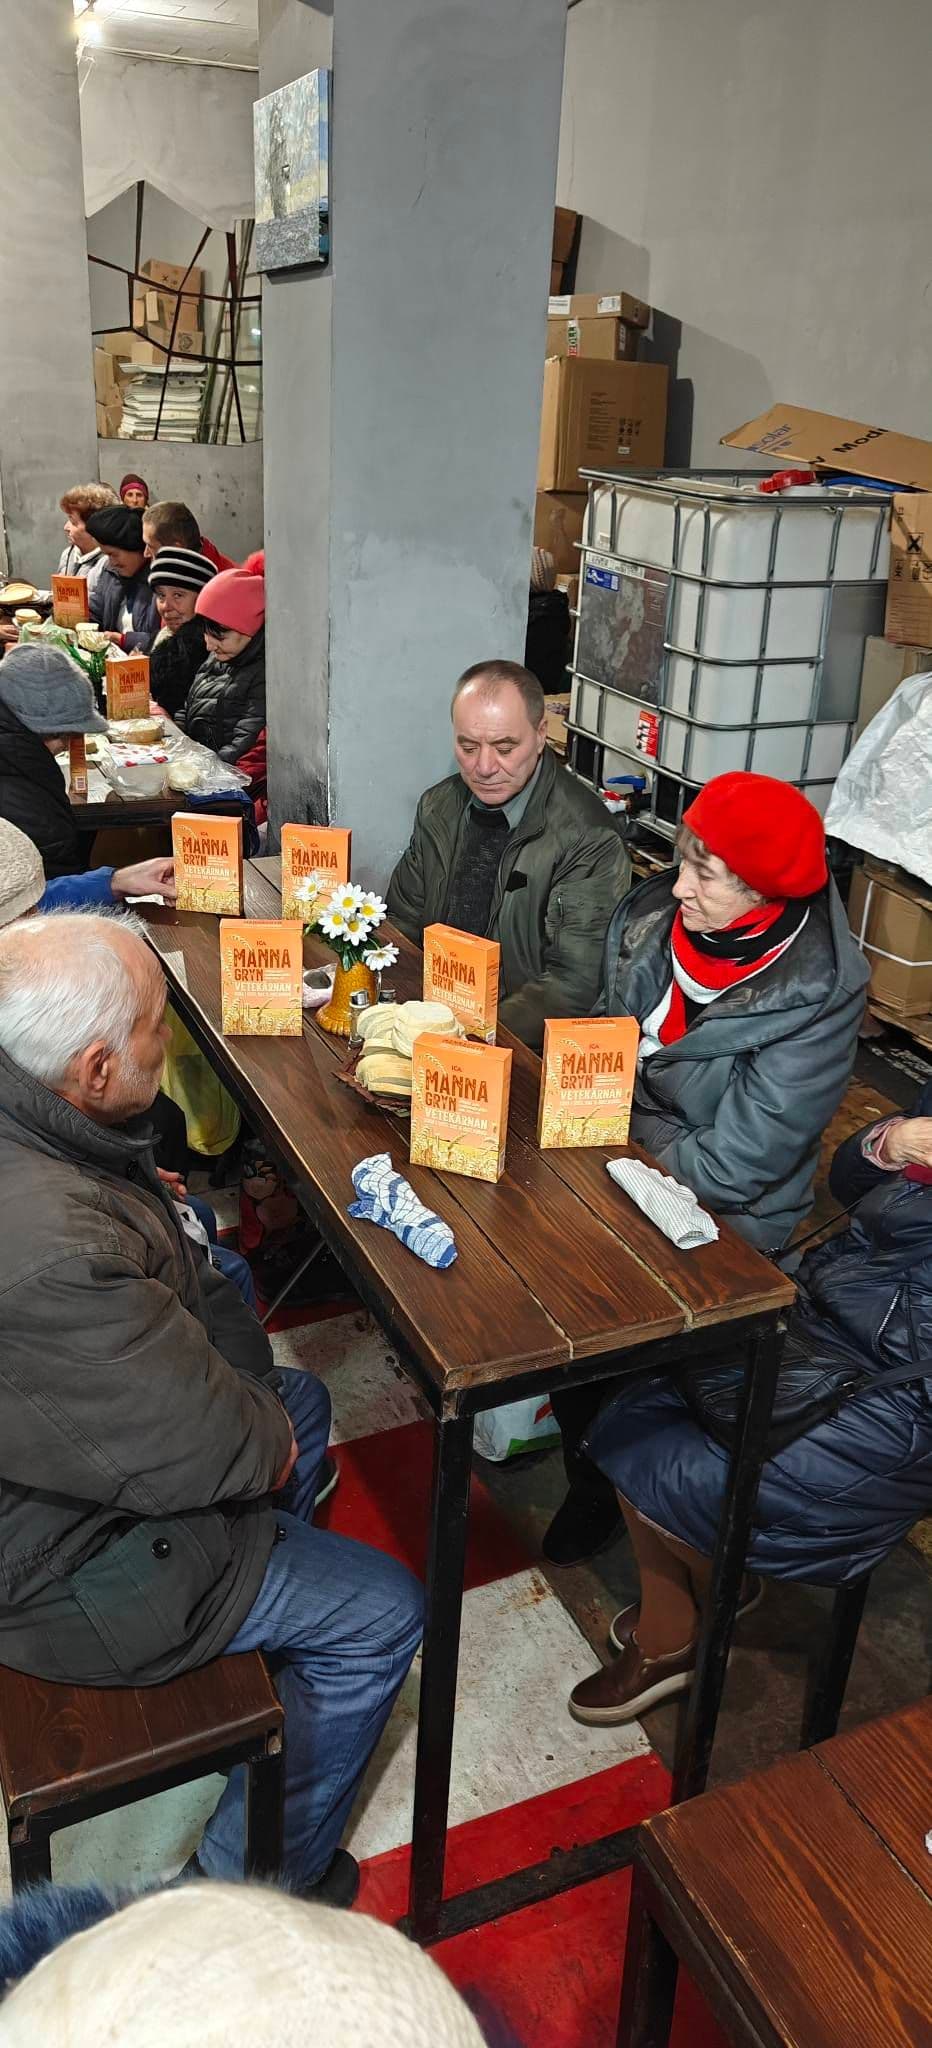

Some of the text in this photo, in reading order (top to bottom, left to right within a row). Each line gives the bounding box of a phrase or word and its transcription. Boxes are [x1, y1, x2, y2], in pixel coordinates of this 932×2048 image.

[119, 671, 145, 685] MANNA
[182, 836, 229, 857] MANNA
[183, 853, 207, 866] GRYN
[291, 847, 338, 868] MANNA
[233, 948, 291, 969] MANNA
[234, 968, 264, 982] GRYN
[432, 953, 476, 986] MANNA
[432, 973, 454, 992] GRYN
[451, 1065, 462, 1073] ICA
[562, 1051, 624, 1075] MANNA
[425, 1068, 489, 1103] MANNA
[560, 1074, 593, 1089] GRYN
[425, 1091, 457, 1112] GRYN
